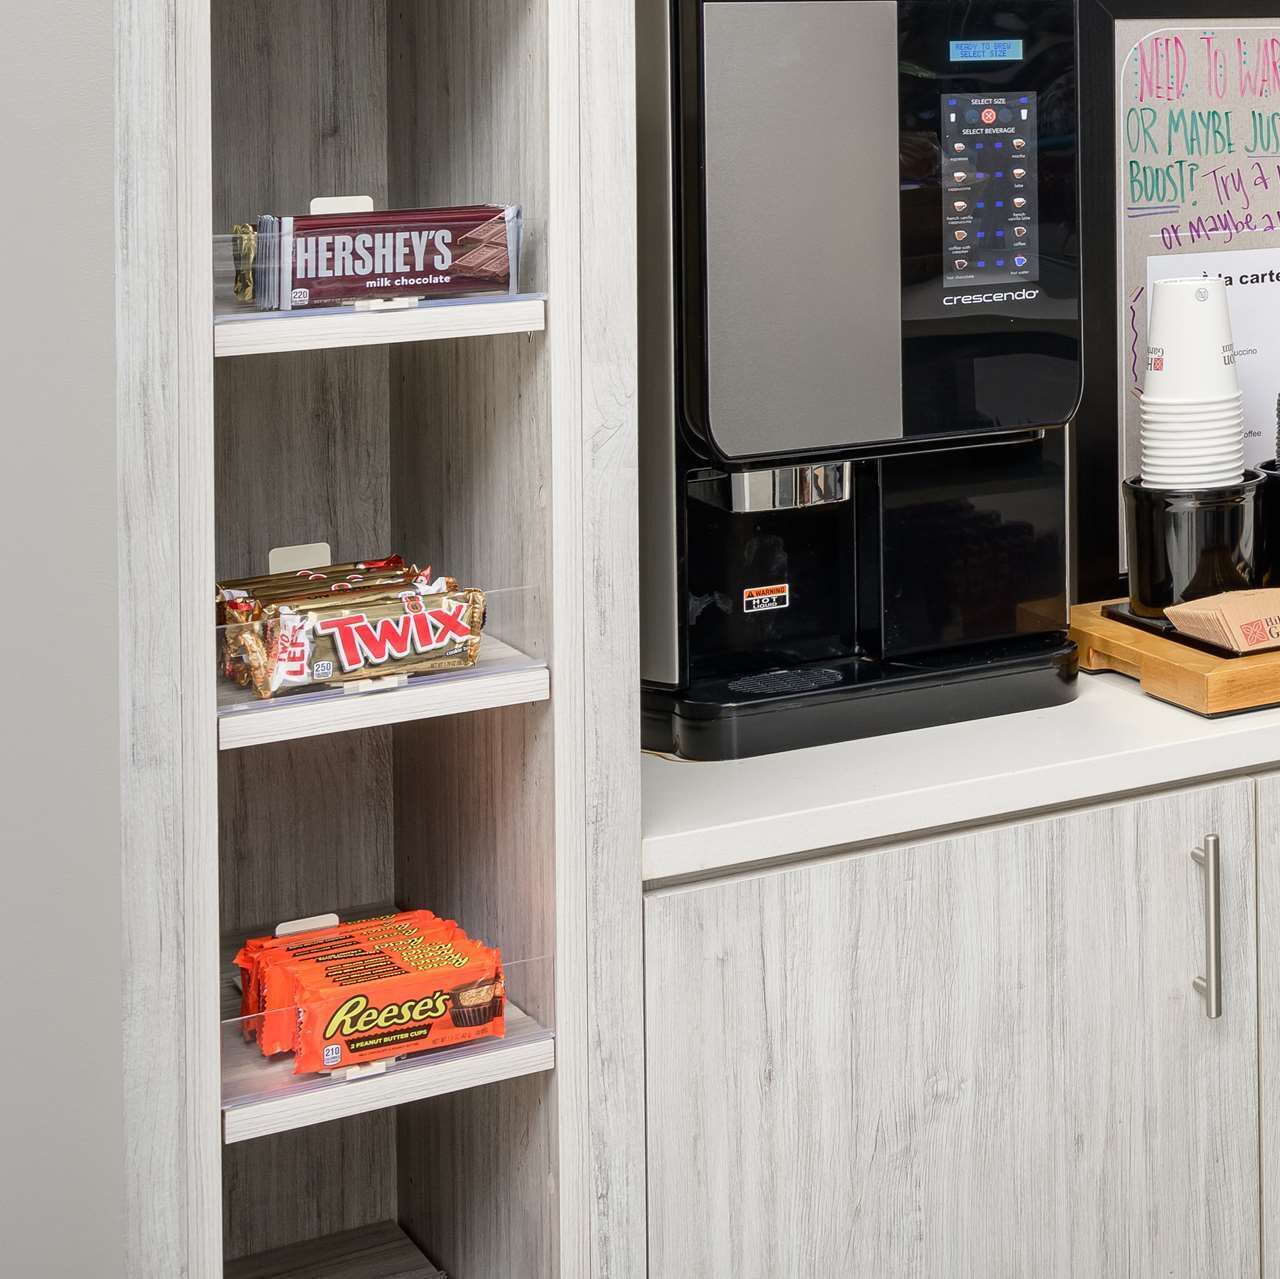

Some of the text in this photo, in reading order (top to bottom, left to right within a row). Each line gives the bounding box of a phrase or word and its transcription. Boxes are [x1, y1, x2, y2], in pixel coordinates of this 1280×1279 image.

[1137, 36, 1188, 102] NEED
[1127, 107, 1158, 154] OR
[1168, 109, 1235, 156] MAYBE
[1128, 159, 1200, 207] BOOST?
[1201, 164, 1250, 210] Try
[295, 229, 452, 279] HERSHEY'S
[366, 275, 450, 288] milk chocolate
[292, 290, 308, 299] 220
[943, 288, 1037, 305] crescendo
[756, 586, 786, 596] WARNING
[752, 596, 777, 605] HOT
[315, 662, 331, 673] 250
[355, 1038, 382, 1049] PEANUT
[383, 1033, 409, 1043] BUTTER
[410, 1028, 428, 1038] CUPS
[325, 1047, 340, 1057] 210
